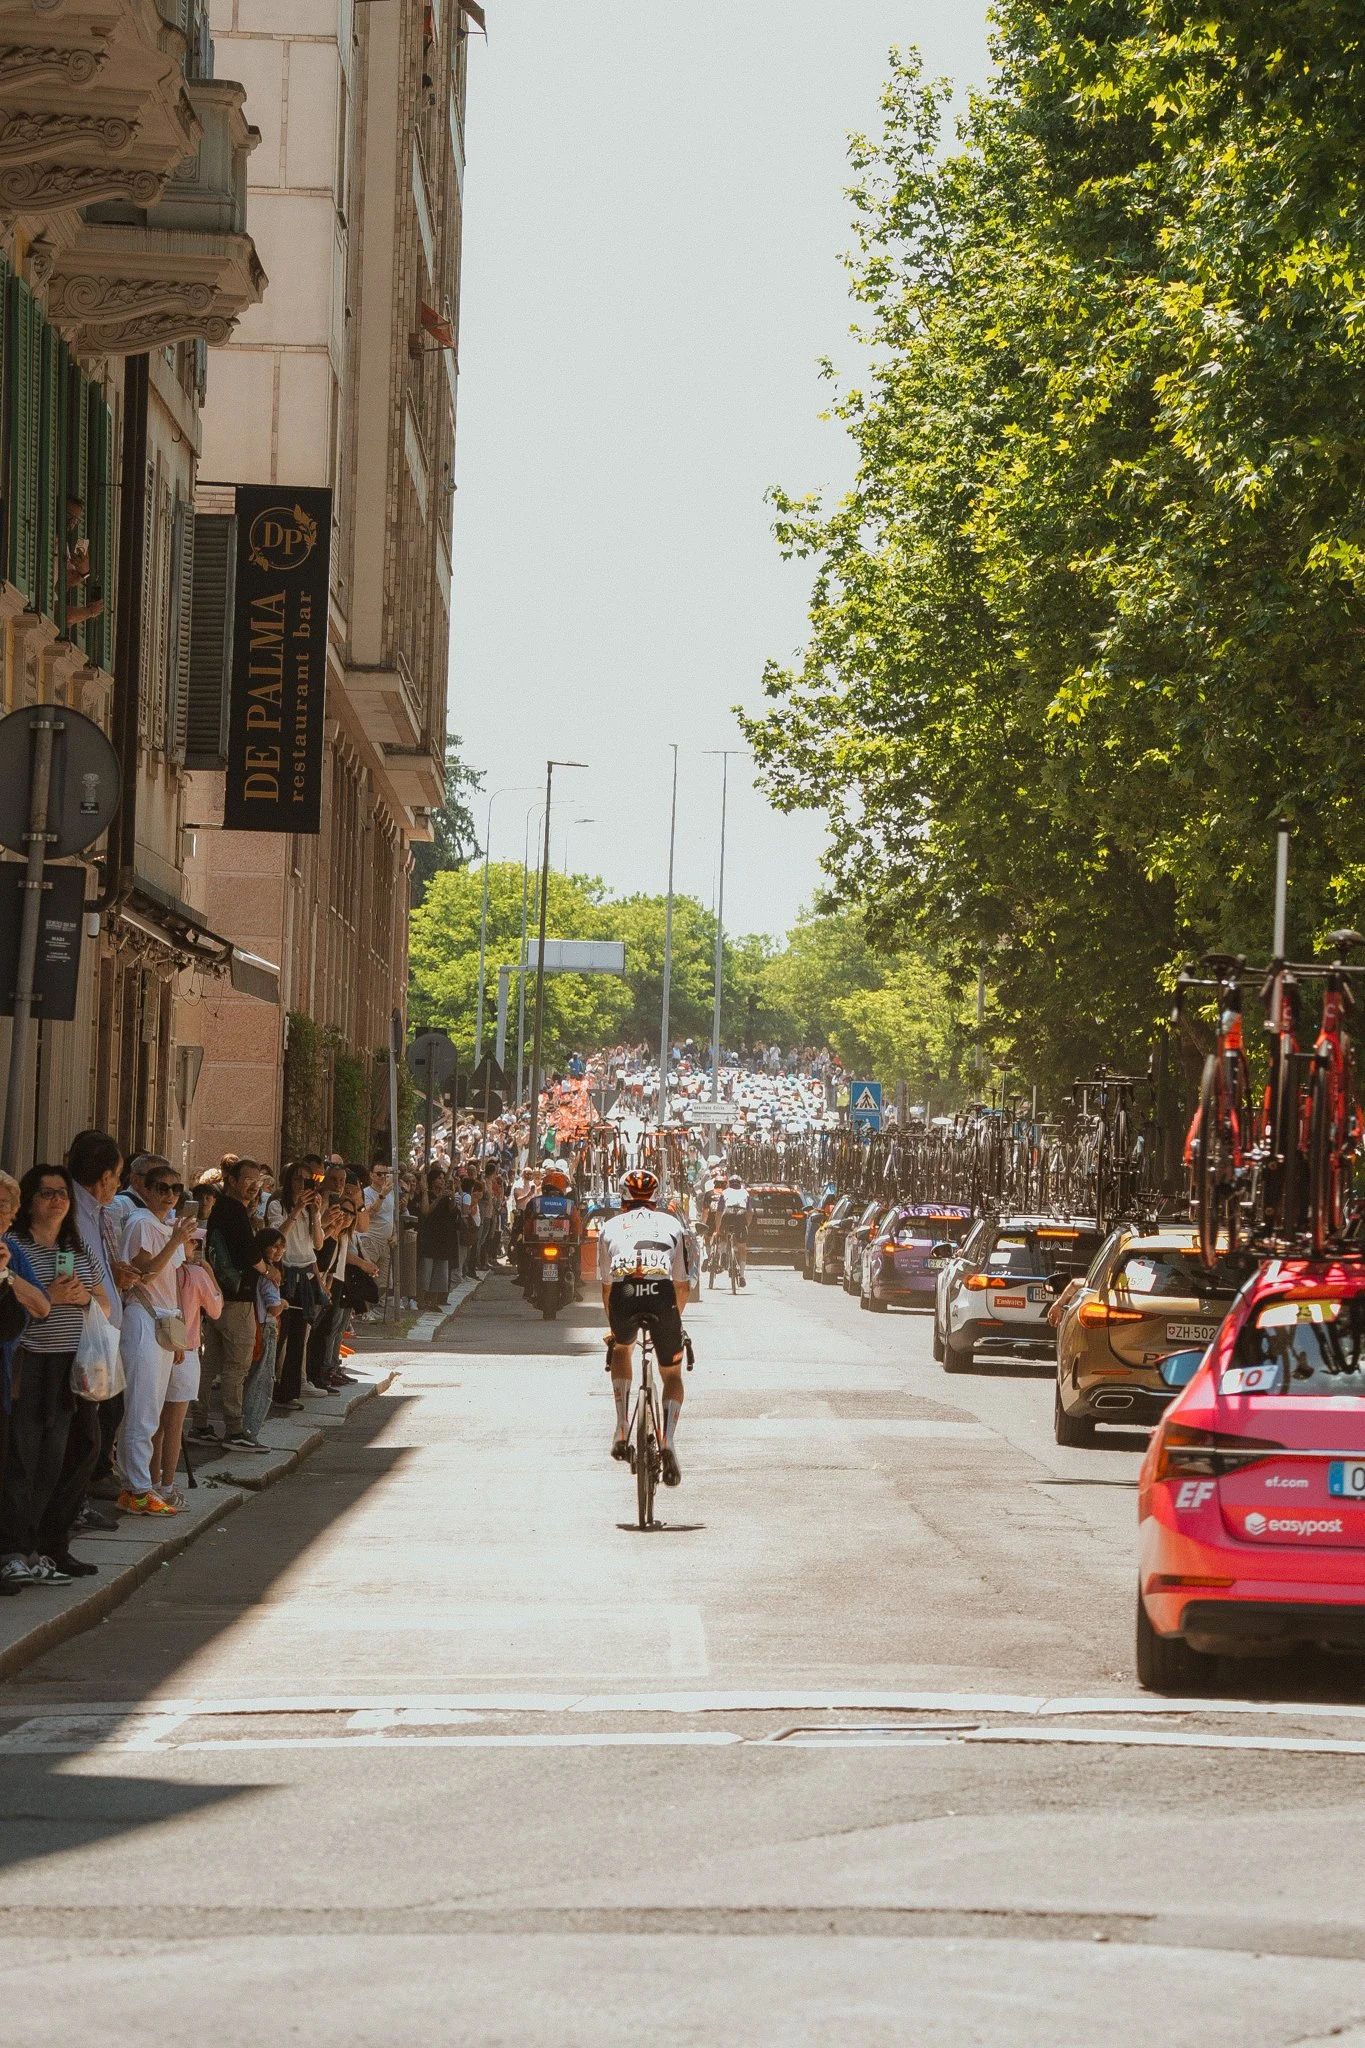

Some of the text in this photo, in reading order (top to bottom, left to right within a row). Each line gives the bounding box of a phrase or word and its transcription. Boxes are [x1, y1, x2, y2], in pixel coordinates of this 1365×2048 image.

[263, 521, 302, 555] DP
[244, 589, 286, 803] DE PALMA
[293, 590, 312, 803] restaurant bar
[1040, 1240, 1073, 1252] UAE
[643, 1253, 668, 1270] 194
[635, 1282, 659, 1297] IHC
[996, 1298, 1024, 1306] Emirates
[1237, 1369, 1263, 1387] 10
[1265, 1476, 1309, 1488] ef.com
[1175, 1481, 1216, 1508] EF
[1268, 1518, 1343, 1536] easypost
